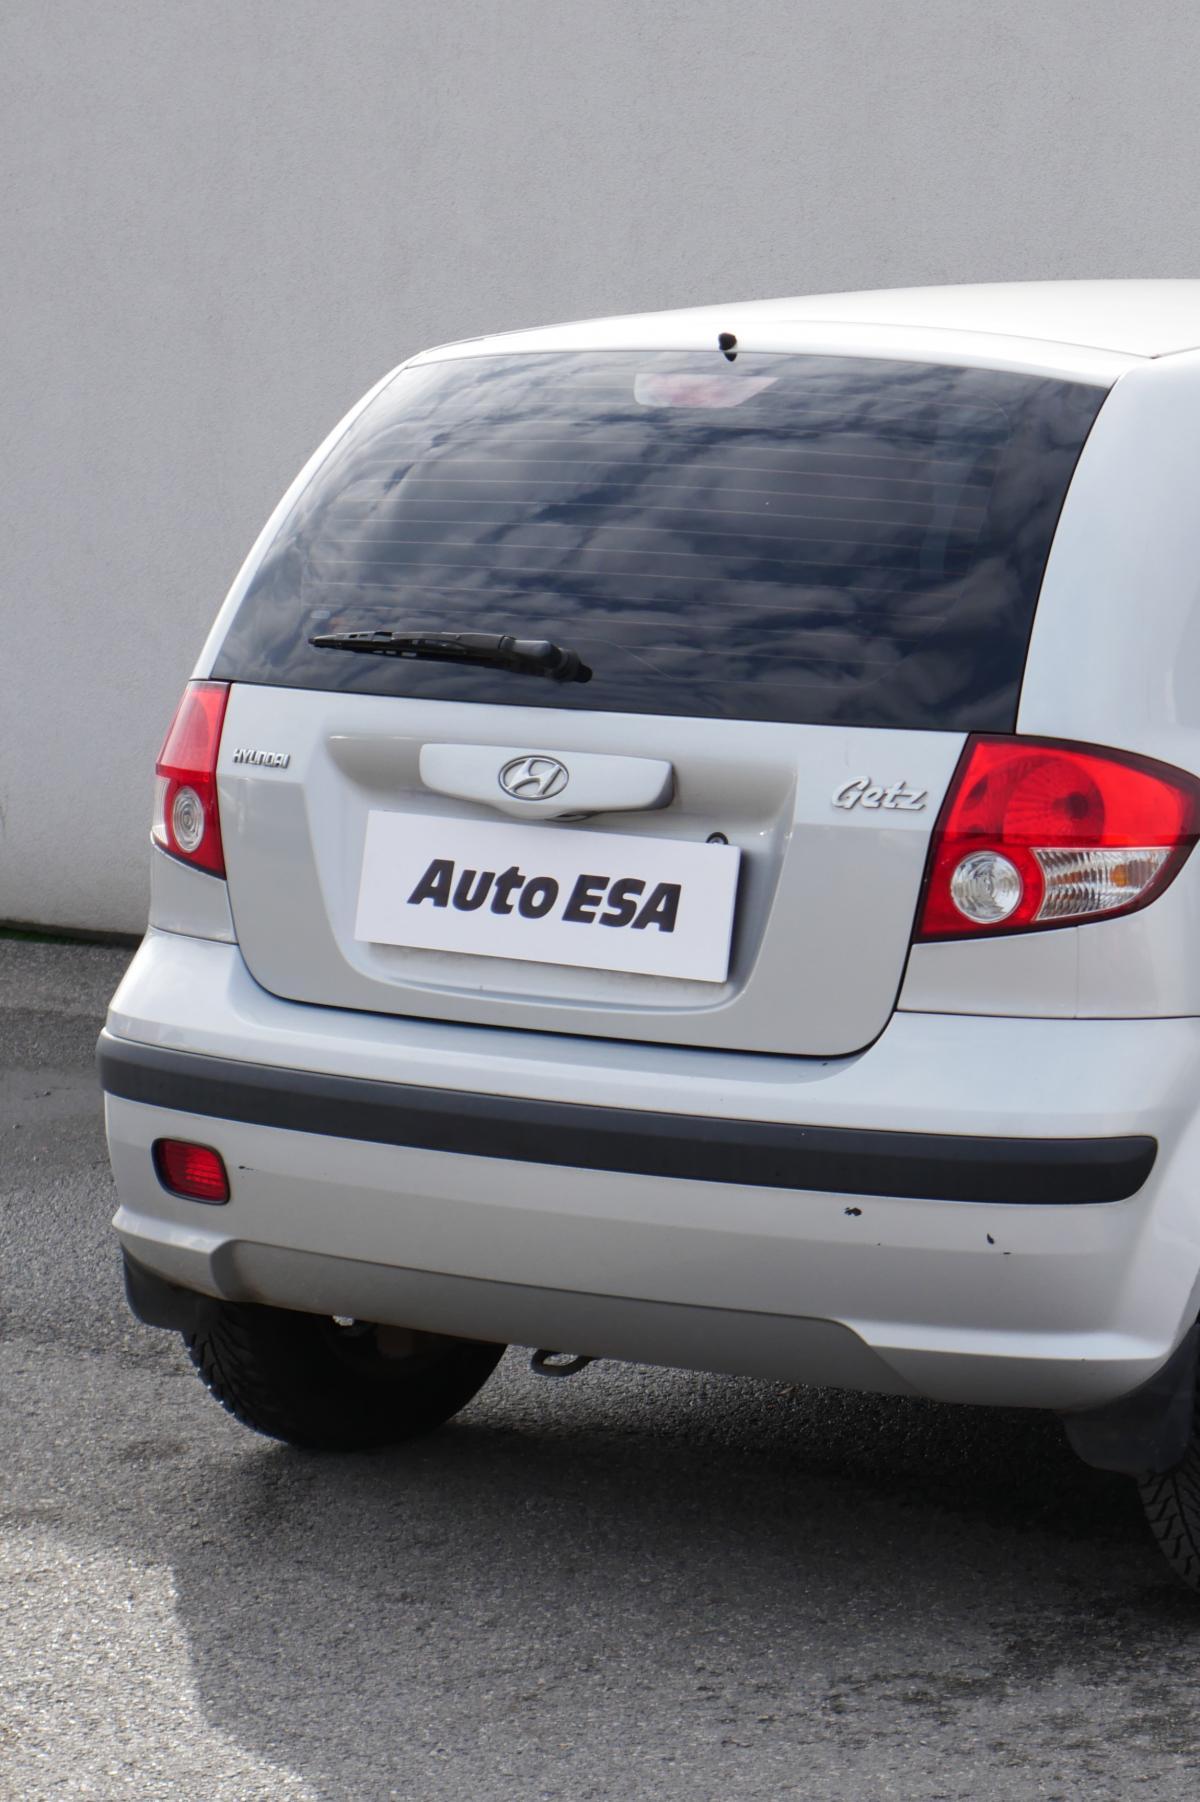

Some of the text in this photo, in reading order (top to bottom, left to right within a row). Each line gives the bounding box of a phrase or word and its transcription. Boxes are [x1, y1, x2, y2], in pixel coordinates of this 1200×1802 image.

[233, 748, 291, 769] HYUNDAI
[832, 775, 929, 811] Getz
[407, 858, 682, 933] Auto ESA
